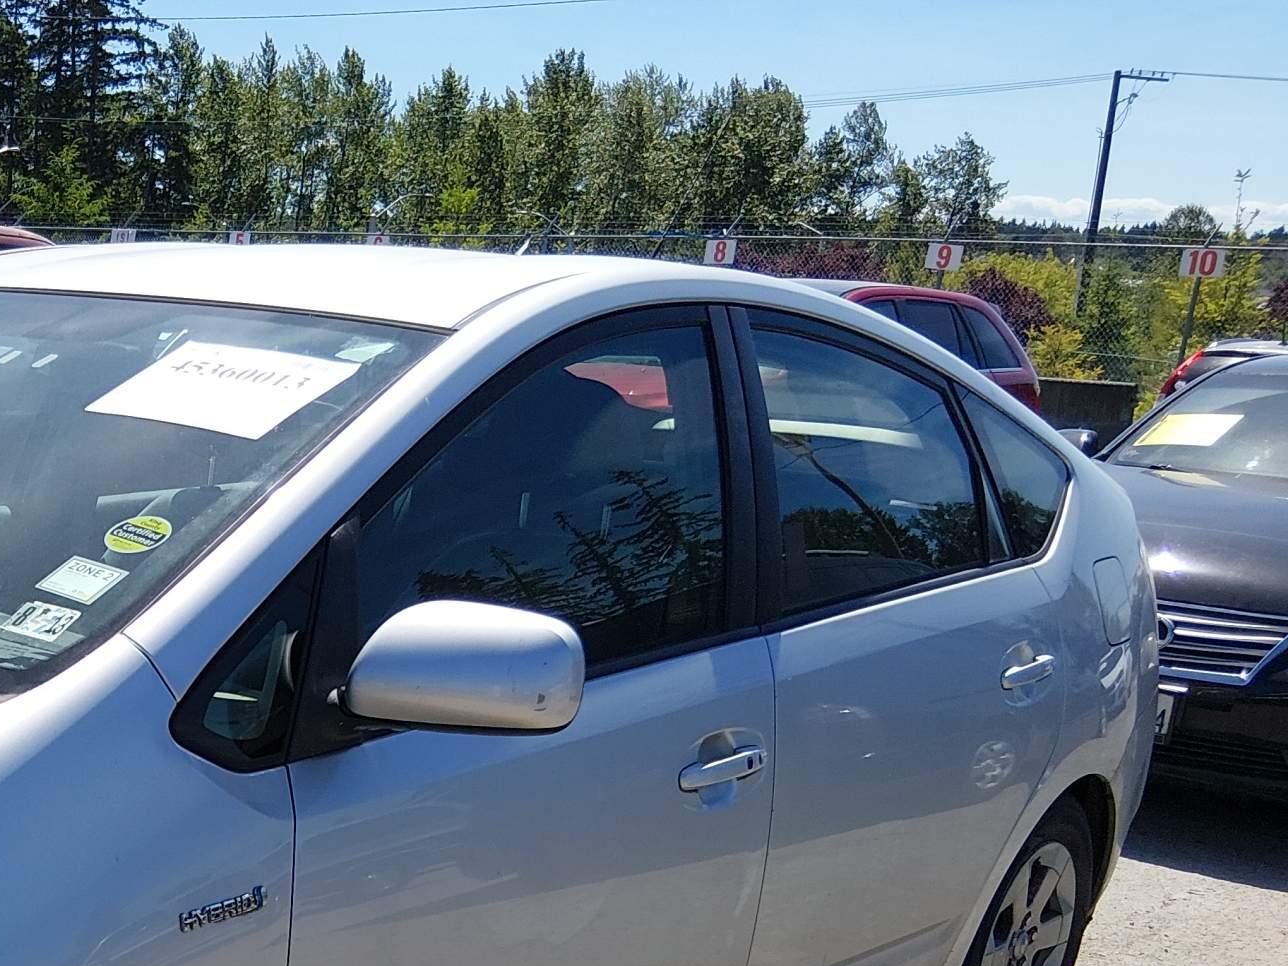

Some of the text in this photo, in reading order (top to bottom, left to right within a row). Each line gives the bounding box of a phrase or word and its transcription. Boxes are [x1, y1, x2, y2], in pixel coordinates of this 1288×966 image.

[713, 240, 727, 263] 8
[936, 243, 953, 269] 9
[1188, 250, 1218, 276] 10
[170, 360, 312, 389] 45360013
[112, 528, 156, 547] Customer
[121, 523, 164, 541] Certified
[67, 561, 105, 578] ZONE
[102, 573, 115, 582] 2
[12, 606, 37, 626] 8
[178, 892, 259, 933] HYBRID
